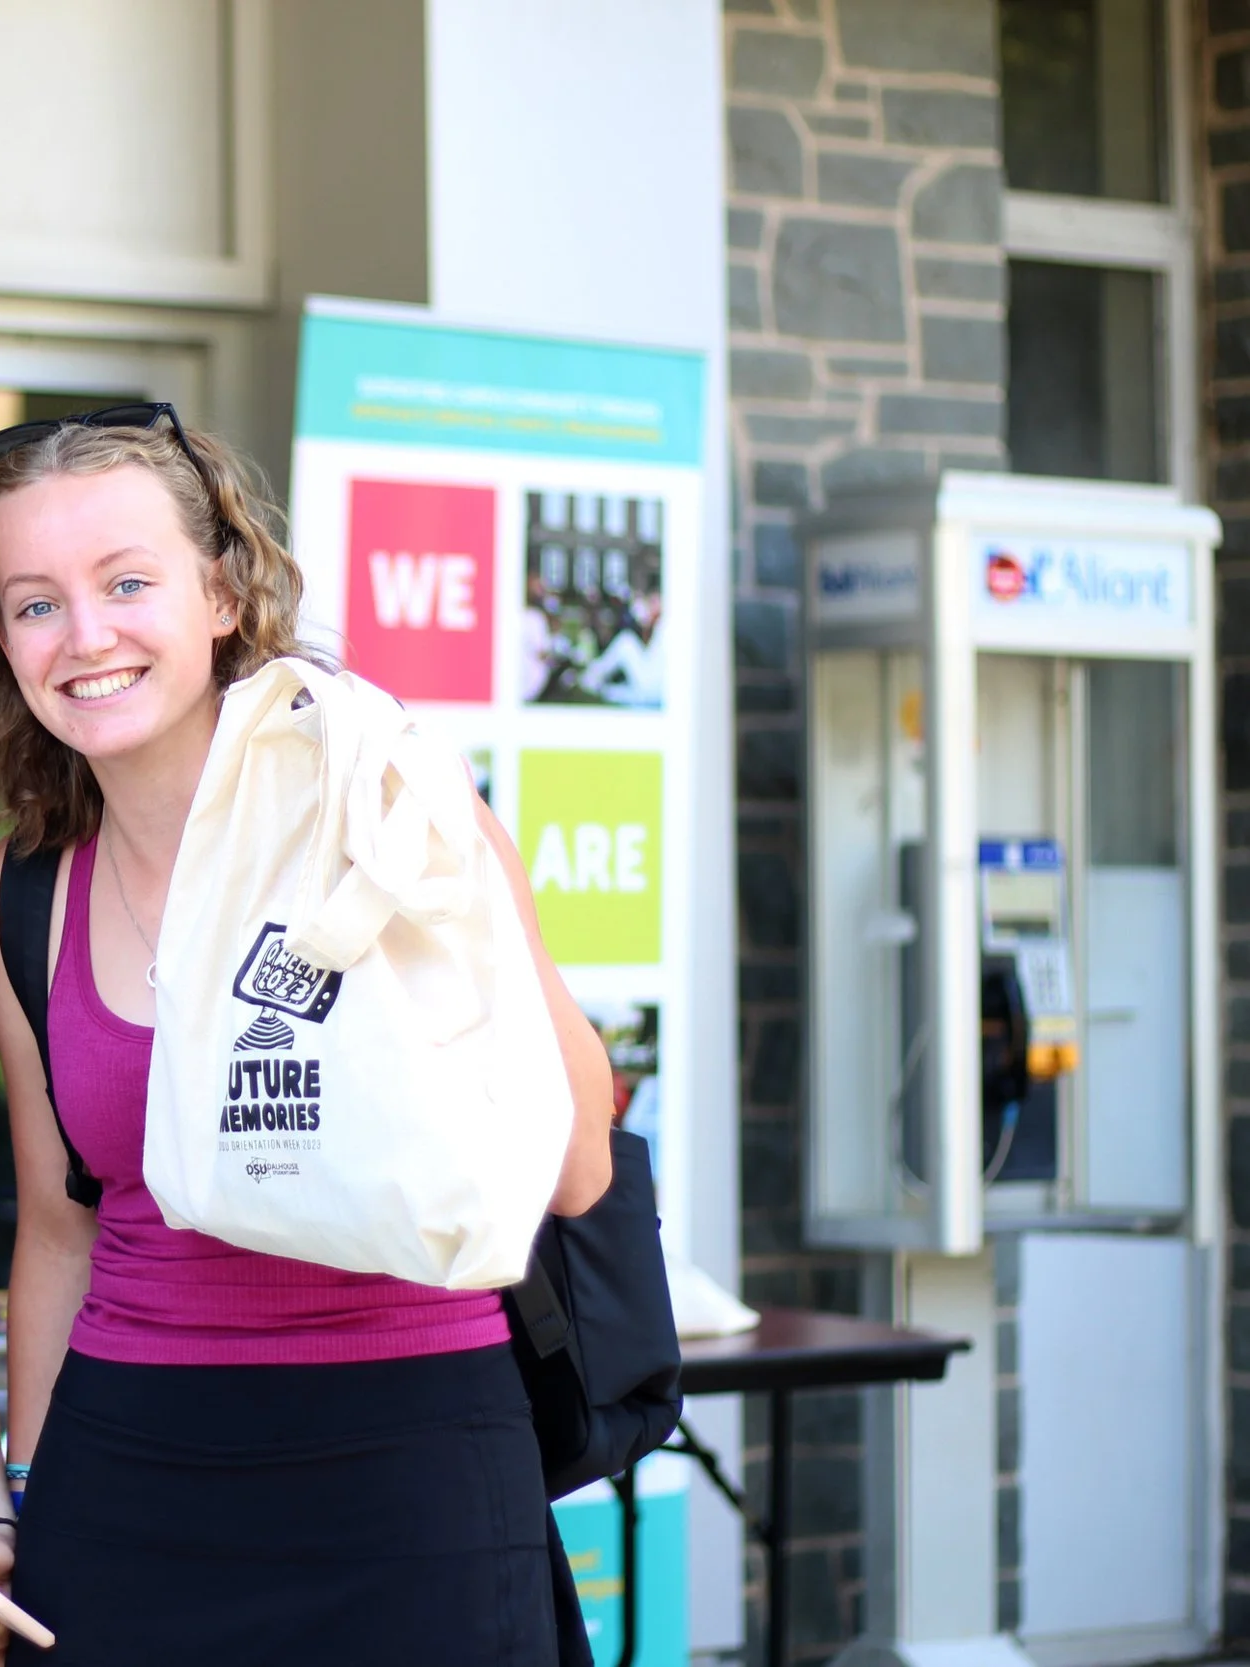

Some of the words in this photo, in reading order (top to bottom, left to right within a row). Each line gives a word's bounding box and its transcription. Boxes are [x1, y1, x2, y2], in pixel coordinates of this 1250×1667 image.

[368, 549, 478, 632] WE
[532, 823, 647, 893] ARE
[258, 965, 311, 1001] 2023
[226, 1059, 321, 1101] UTURE
[231, 1139, 281, 1152] ORIENTATION
[283, 1139, 301, 1151] WEEK
[302, 1138, 321, 1151] 2023
[246, 1163, 267, 1176] DSU
